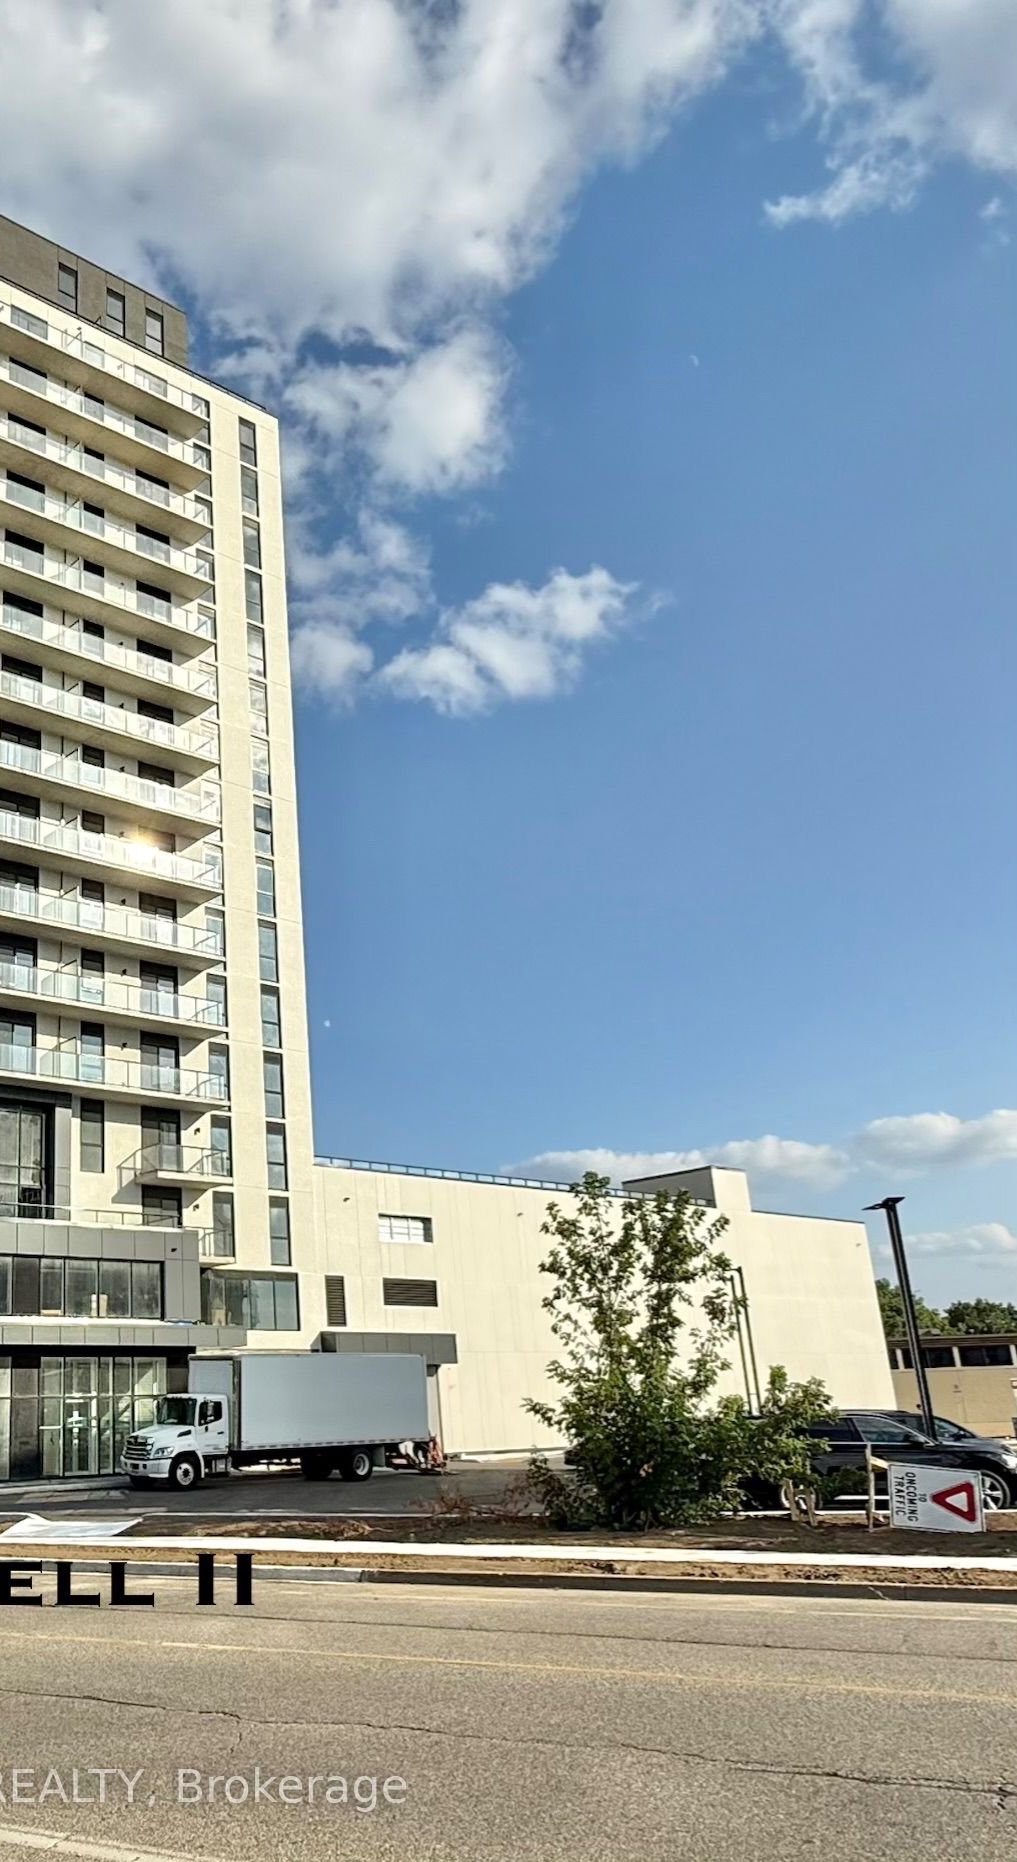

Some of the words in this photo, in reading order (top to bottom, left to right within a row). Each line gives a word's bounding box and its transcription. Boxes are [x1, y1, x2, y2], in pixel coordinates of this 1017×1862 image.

[894, 1476, 906, 1516] TRAFFIC
[905, 1472, 919, 1522] ONCOMING
[918, 1493, 927, 1502] TO
